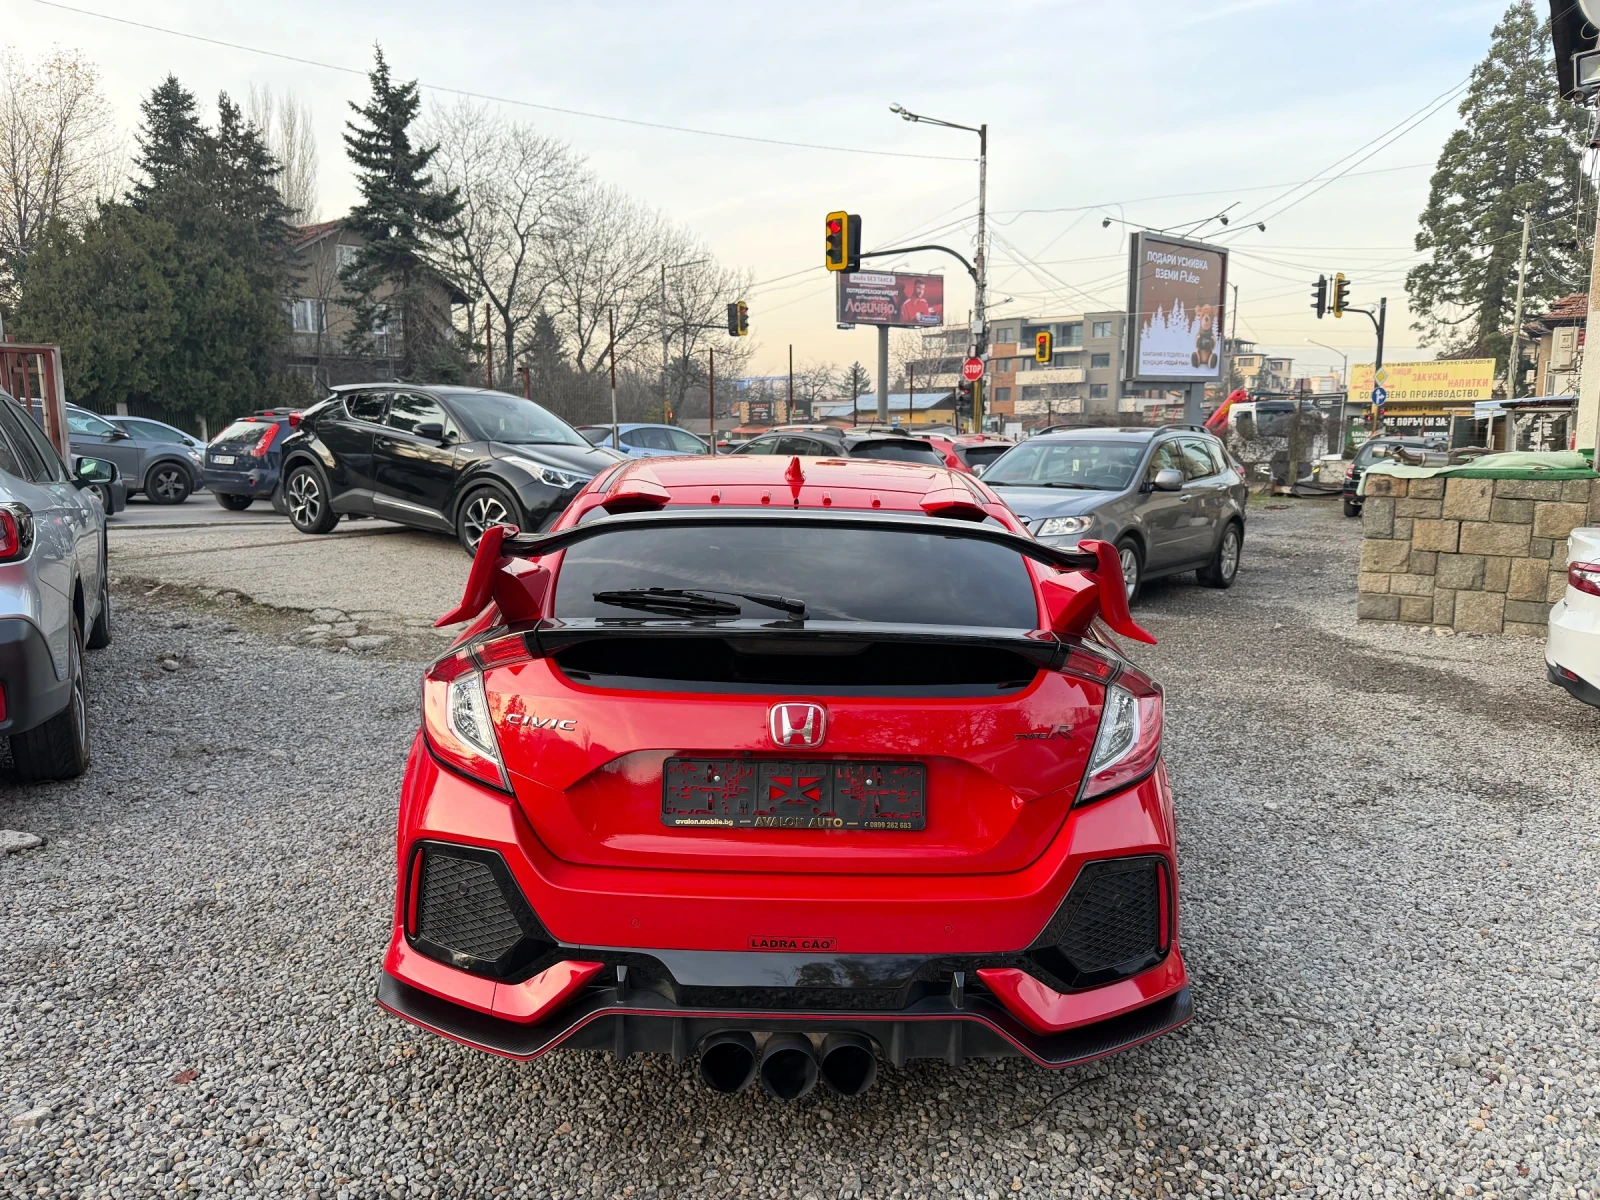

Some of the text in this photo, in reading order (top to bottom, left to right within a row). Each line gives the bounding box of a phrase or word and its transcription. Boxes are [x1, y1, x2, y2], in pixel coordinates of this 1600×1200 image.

[1147, 251, 1208, 270] ПОДАРИ УСМИВКА
[1155, 268, 1200, 284] ВЗЕМИ Pulse
[964, 364, 982, 374] STOP
[1412, 372, 1448, 382] ЗАКУСКИ
[1448, 378, 1489, 388] НАПИТКИ
[1359, 389, 1479, 399] СОВЕНО ПРОИЗВОДСТВО
[505, 713, 578, 731] CIVIC
[1014, 724, 1075, 740] TYPE R
[675, 818, 734, 827] avalon.mobile.bg
[754, 816, 804, 827] AVALON
[808, 817, 843, 828] AUTO
[751, 939, 797, 949] LADRA
